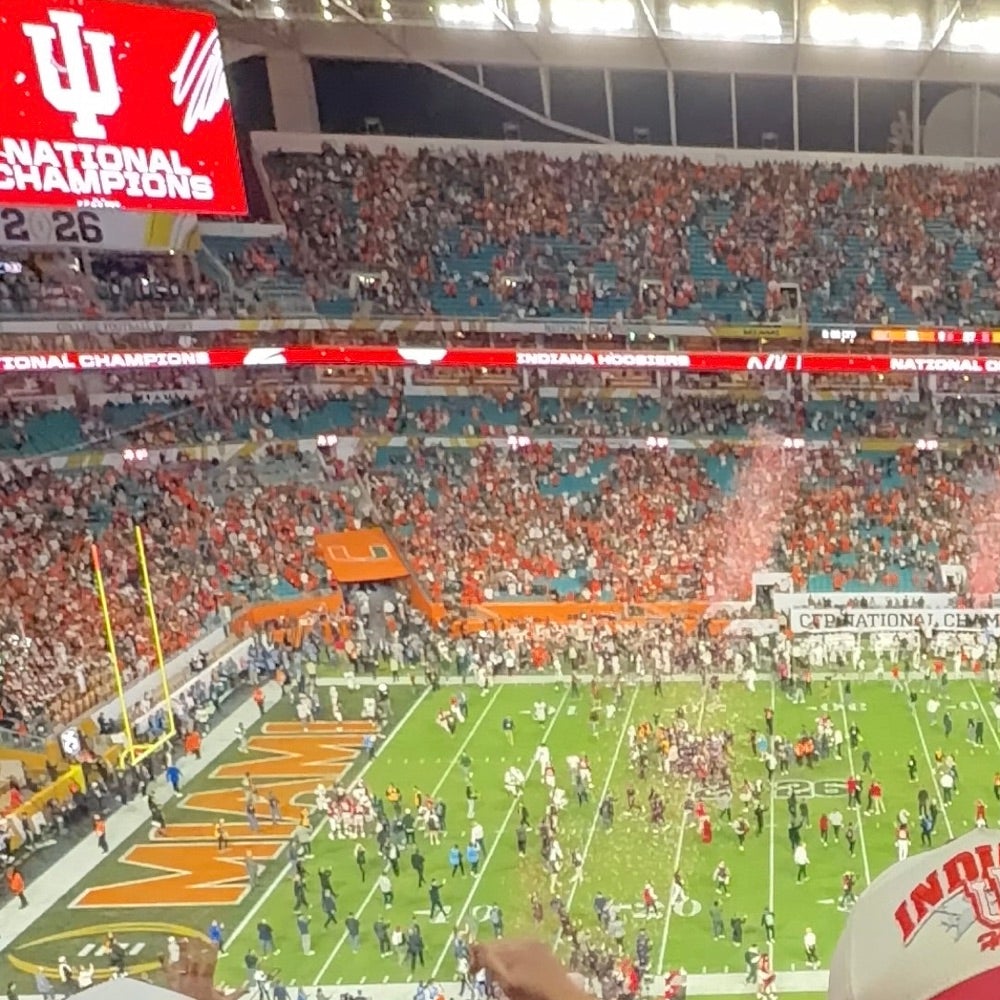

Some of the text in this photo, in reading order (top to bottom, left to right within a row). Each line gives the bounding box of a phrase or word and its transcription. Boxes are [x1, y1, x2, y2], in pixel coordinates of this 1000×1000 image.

[1, 138, 192, 176] NATIONAL
[0, 163, 214, 200] CHAMPIONS
[52, 210, 103, 243] 26
[78, 351, 210, 368] CHAMPIONS
[516, 353, 596, 365] INDIANA
[890, 358, 983, 372] NATIONAL
